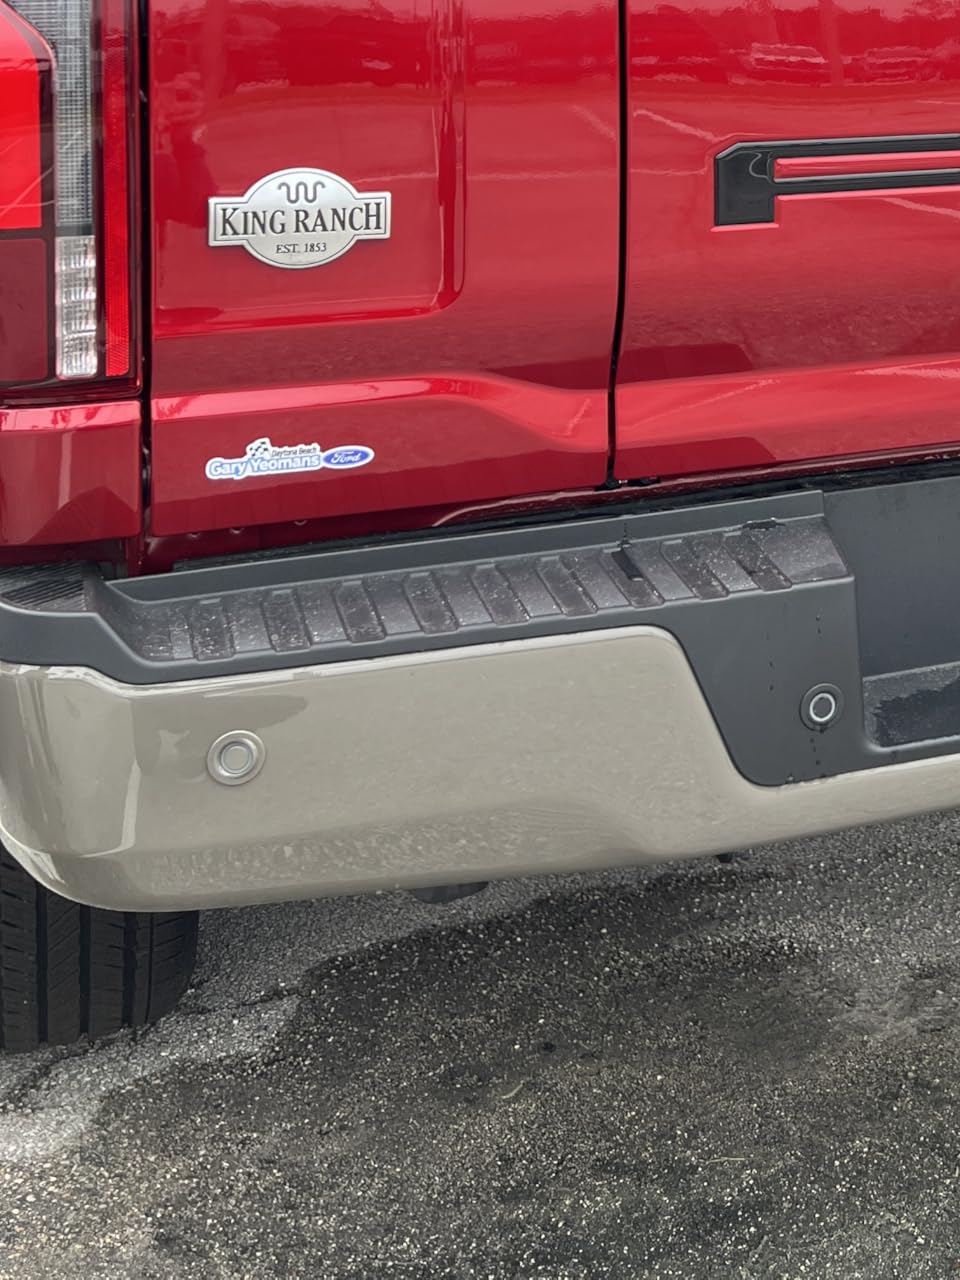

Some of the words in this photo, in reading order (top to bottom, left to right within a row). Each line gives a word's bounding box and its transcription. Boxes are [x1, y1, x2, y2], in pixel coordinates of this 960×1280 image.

[220, 207, 286, 237] KING
[294, 202, 382, 233] RANCH
[276, 243, 300, 254] EST.
[303, 242, 327, 253] 1853
[271, 449, 298, 458] Daytona
[298, 446, 317, 456] Beach
[330, 451, 362, 464] Ford
[209, 460, 247, 477] Gary
[249, 454, 321, 472] Yeomans
